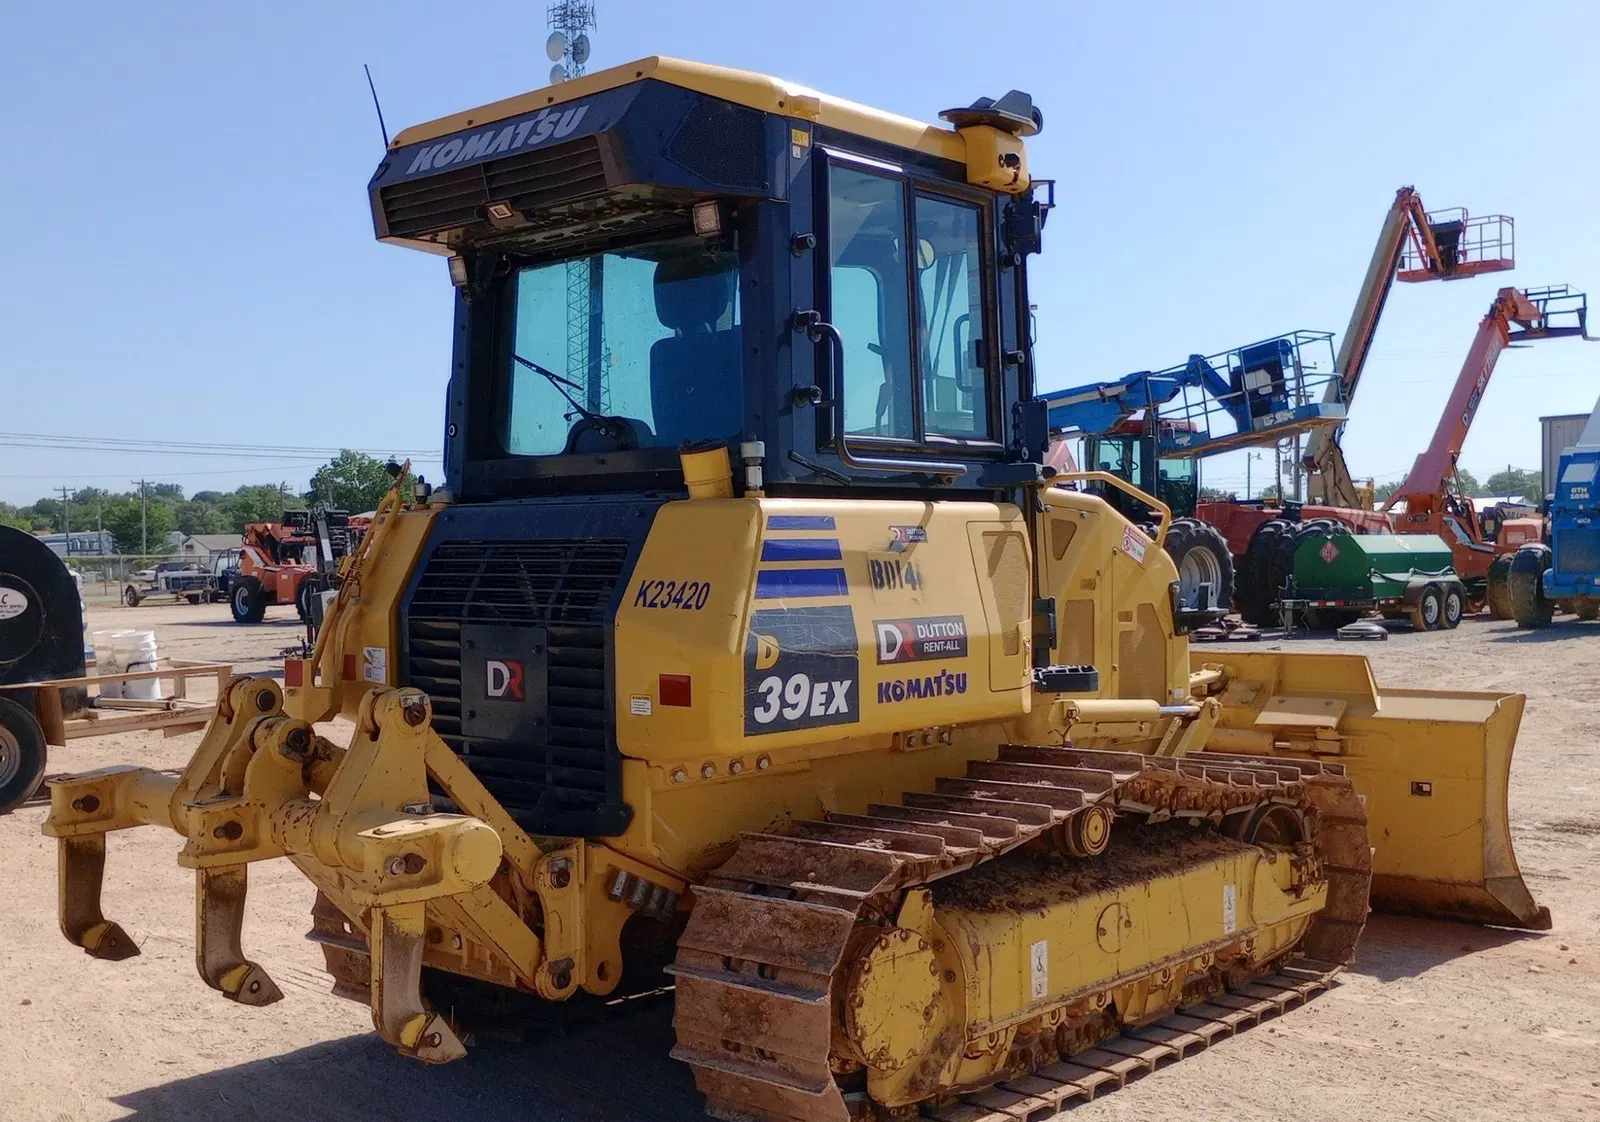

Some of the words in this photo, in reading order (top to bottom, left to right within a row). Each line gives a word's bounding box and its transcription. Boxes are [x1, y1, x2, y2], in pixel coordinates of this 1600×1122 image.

[405, 105, 590, 175] KOMATSU
[633, 580, 711, 610] K23420
[916, 622, 964, 639] DUTTON
[923, 640, 960, 653] RENT-ALL
[755, 633, 781, 670] D
[487, 660, 524, 699] DR
[877, 669, 967, 704] KOMATSU
[754, 673, 853, 724] 39EX
